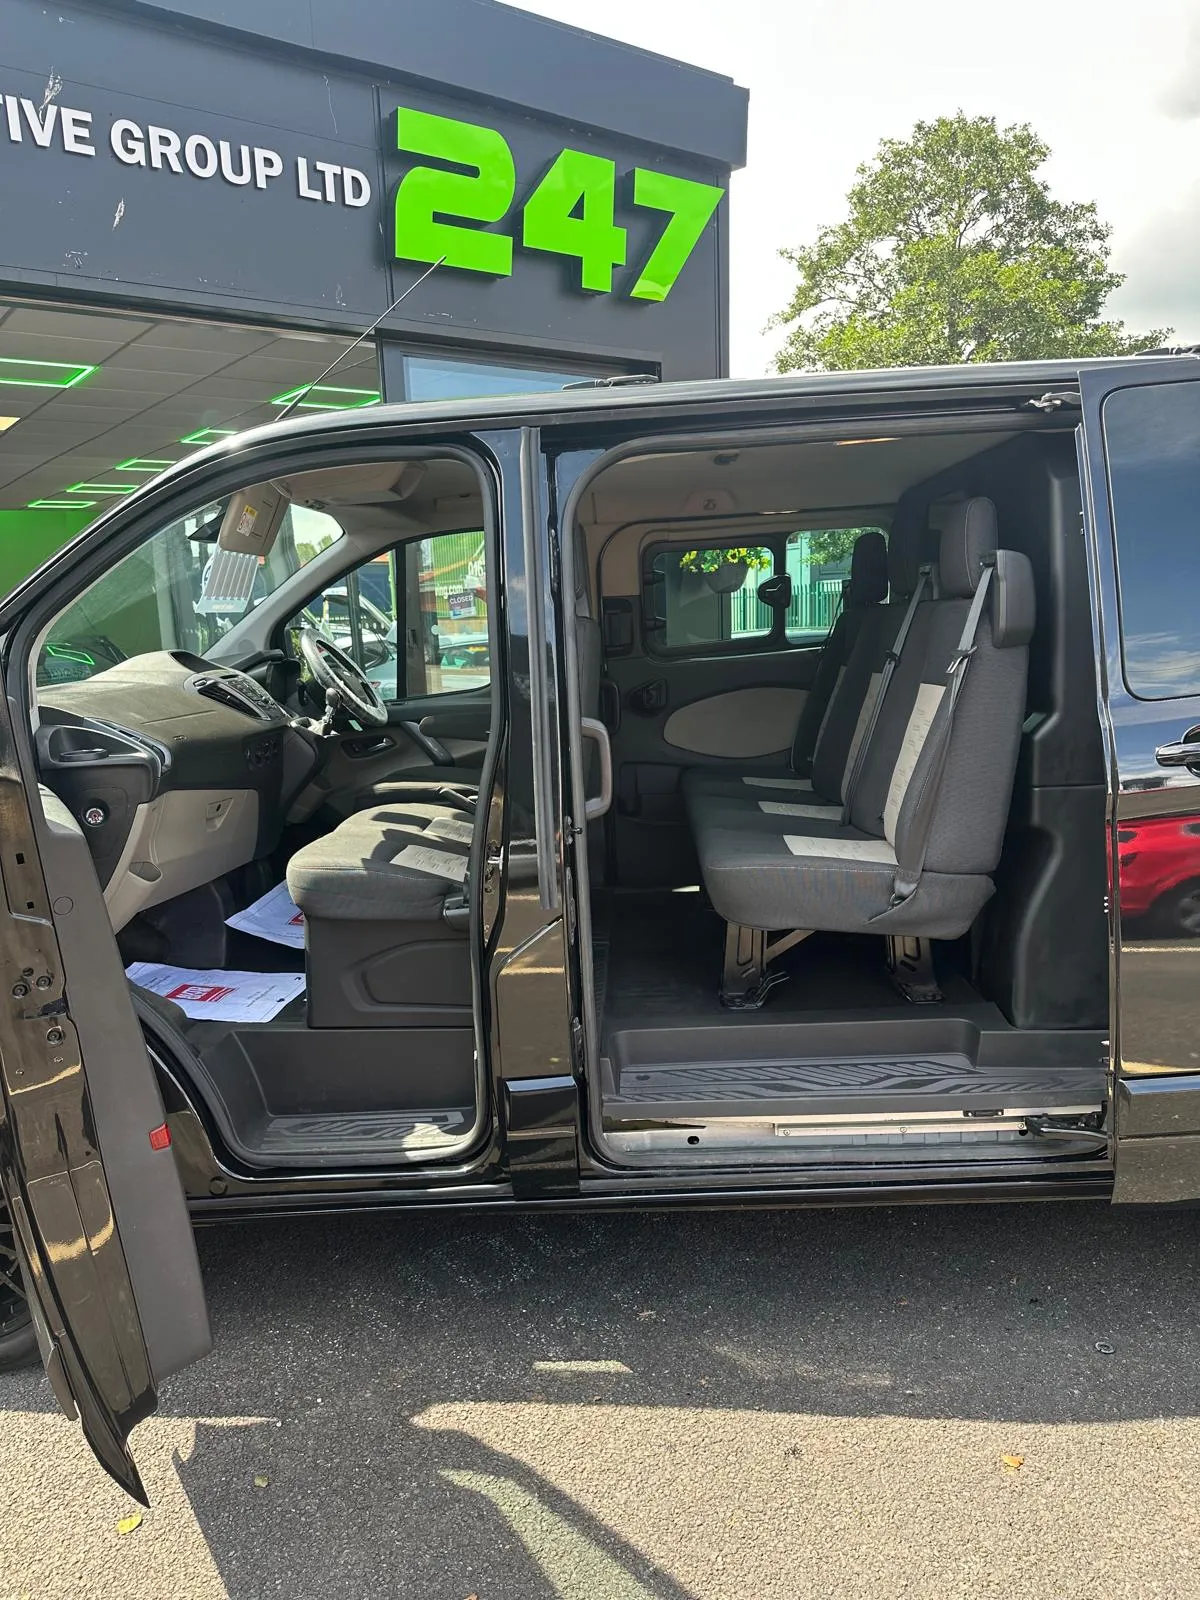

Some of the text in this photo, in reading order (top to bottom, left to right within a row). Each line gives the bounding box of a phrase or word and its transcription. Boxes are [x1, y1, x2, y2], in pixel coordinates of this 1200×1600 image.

[110, 118, 284, 189] GROUP
[297, 156, 372, 208] LTD
[394, 106, 726, 303] 247
[449, 595, 474, 605] CLOSED
